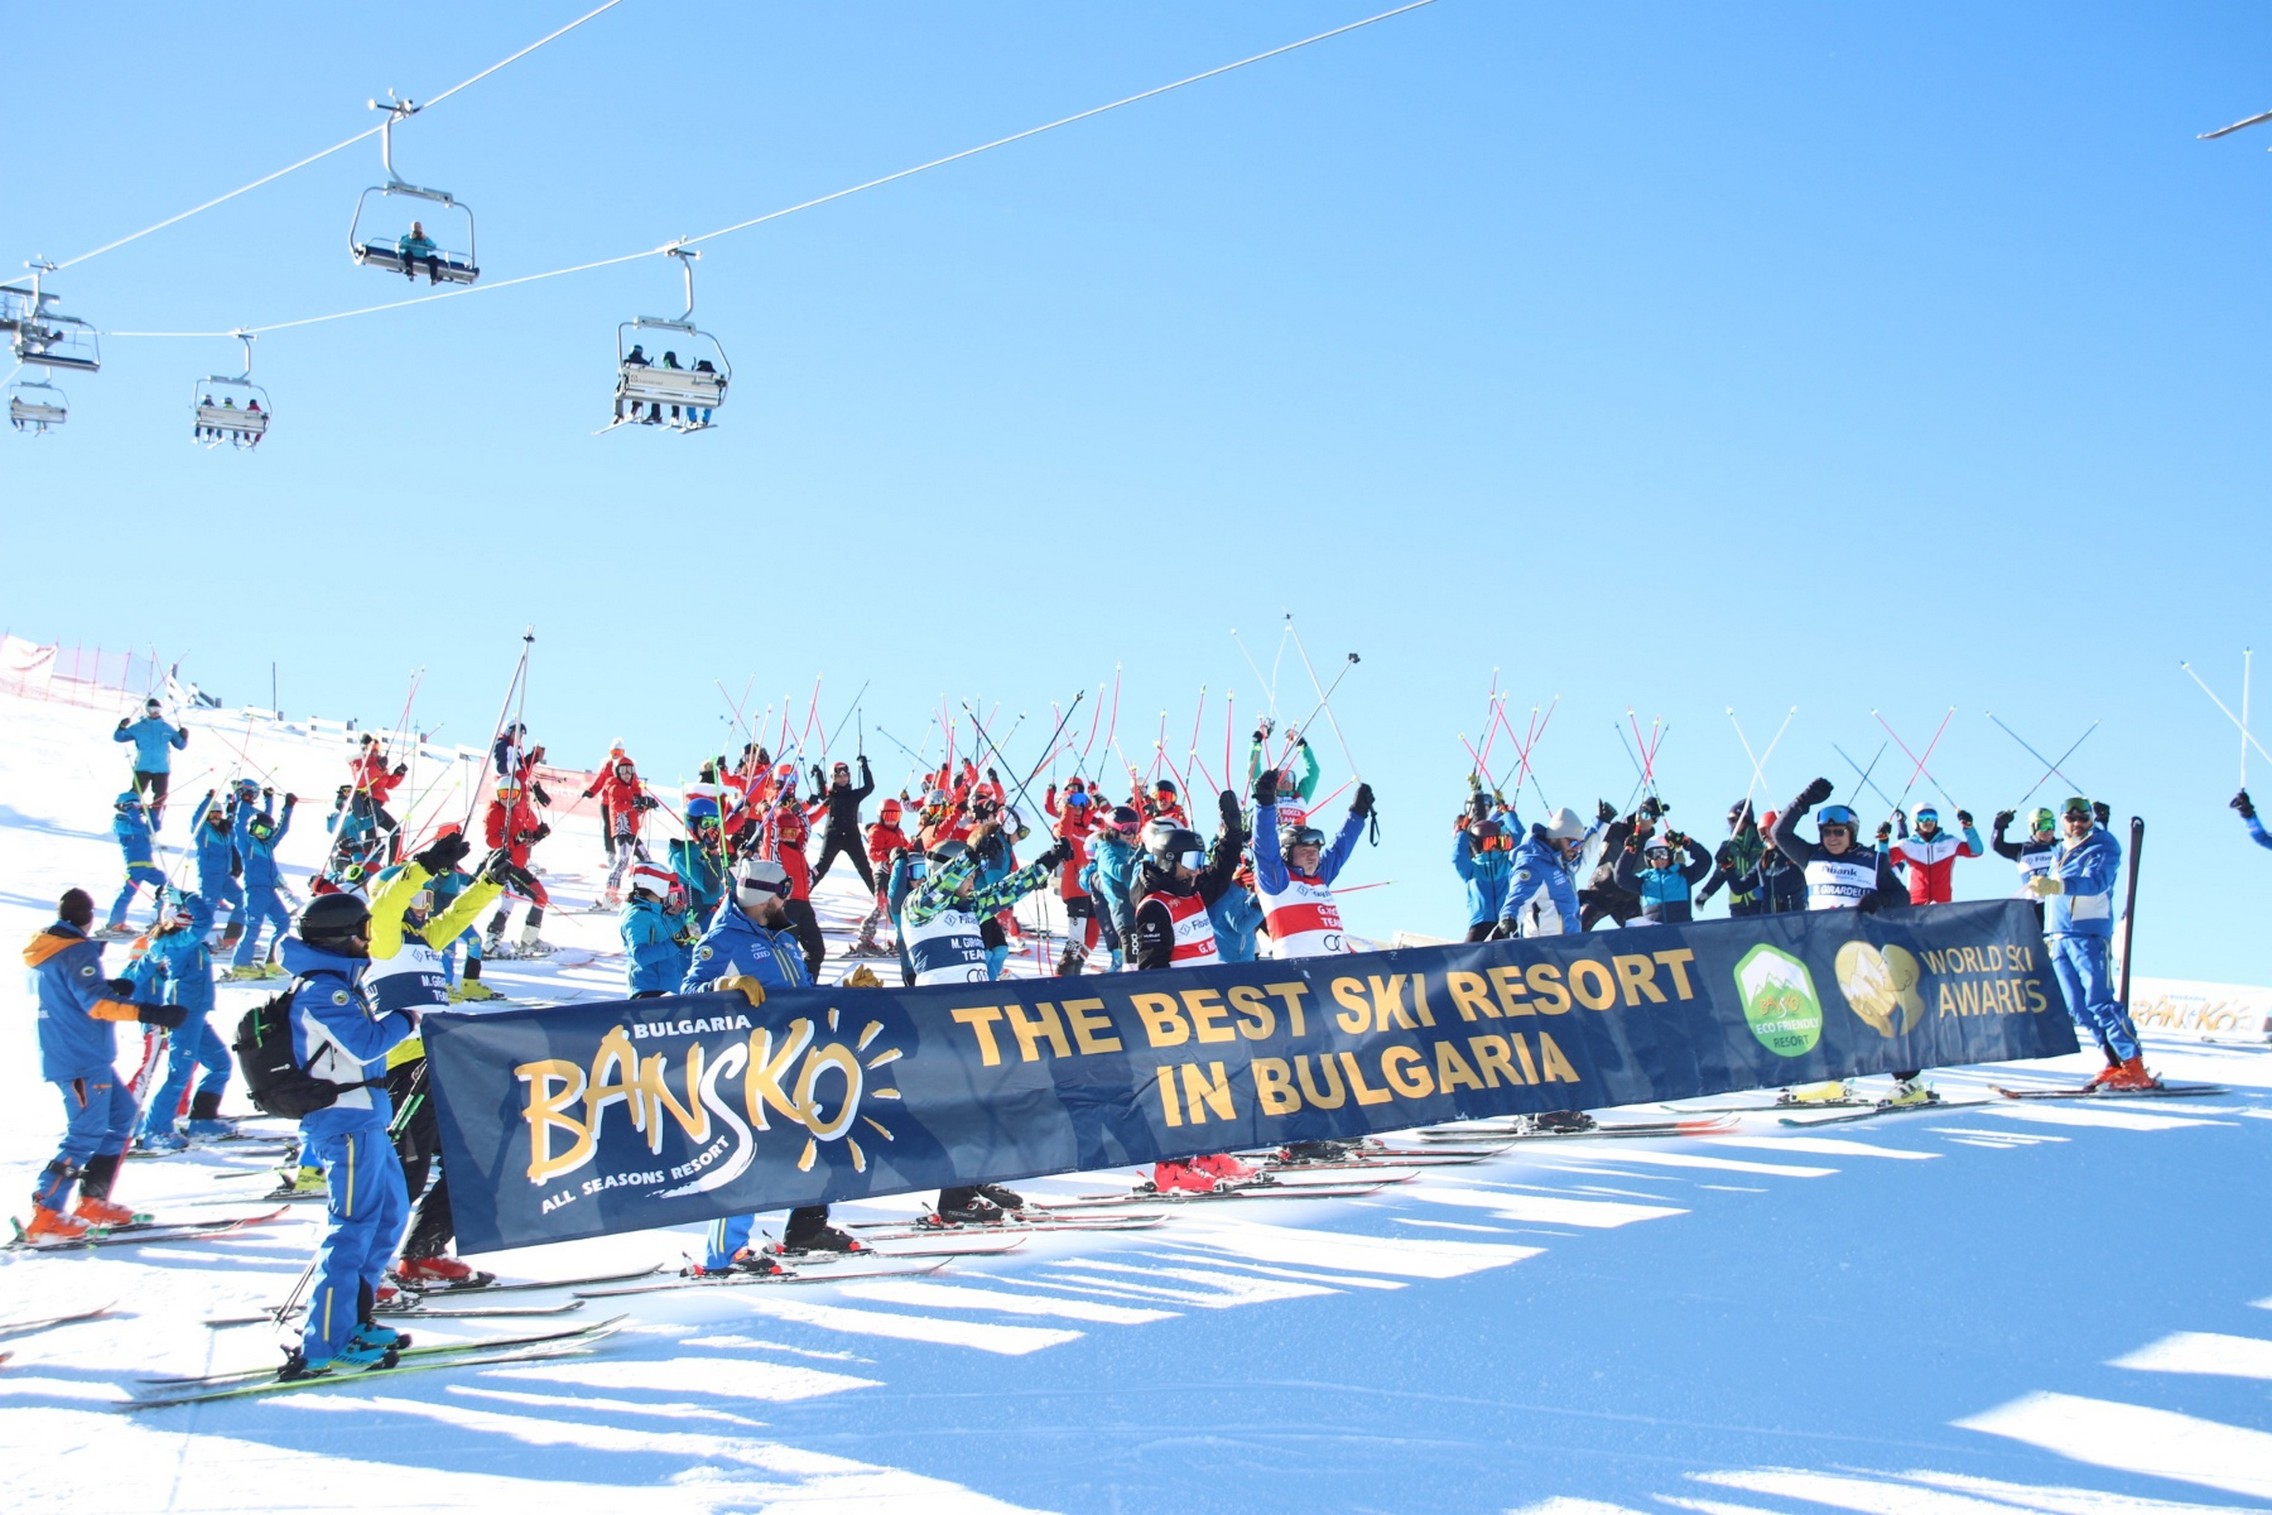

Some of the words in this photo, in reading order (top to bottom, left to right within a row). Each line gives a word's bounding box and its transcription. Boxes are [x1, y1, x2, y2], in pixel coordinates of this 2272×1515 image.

[1919, 945, 2003, 975] WORLD
[2006, 944, 2034, 972] SKI
[950, 997, 1123, 1067] THE
[1129, 981, 1309, 1048] BEST
[1331, 973, 1437, 1035] SKI
[1446, 948, 1694, 1022] RESORT
[1938, 978, 2048, 1018] AWARDS
[634, 1014, 752, 1039] BULGARIA
[1756, 1023, 1776, 1034] ECO
[1777, 1017, 1819, 1031] FRIENDLY
[1773, 1034, 1809, 1048] RESORT
[1157, 1061, 1237, 1127] IN
[1251, 1031, 1581, 1117] BULGARIA
[513, 1017, 864, 1198] BANSKO
[540, 1191, 577, 1214] ALL
[582, 1170, 665, 1195] SEASONS
[670, 1135, 730, 1180] RESORT
